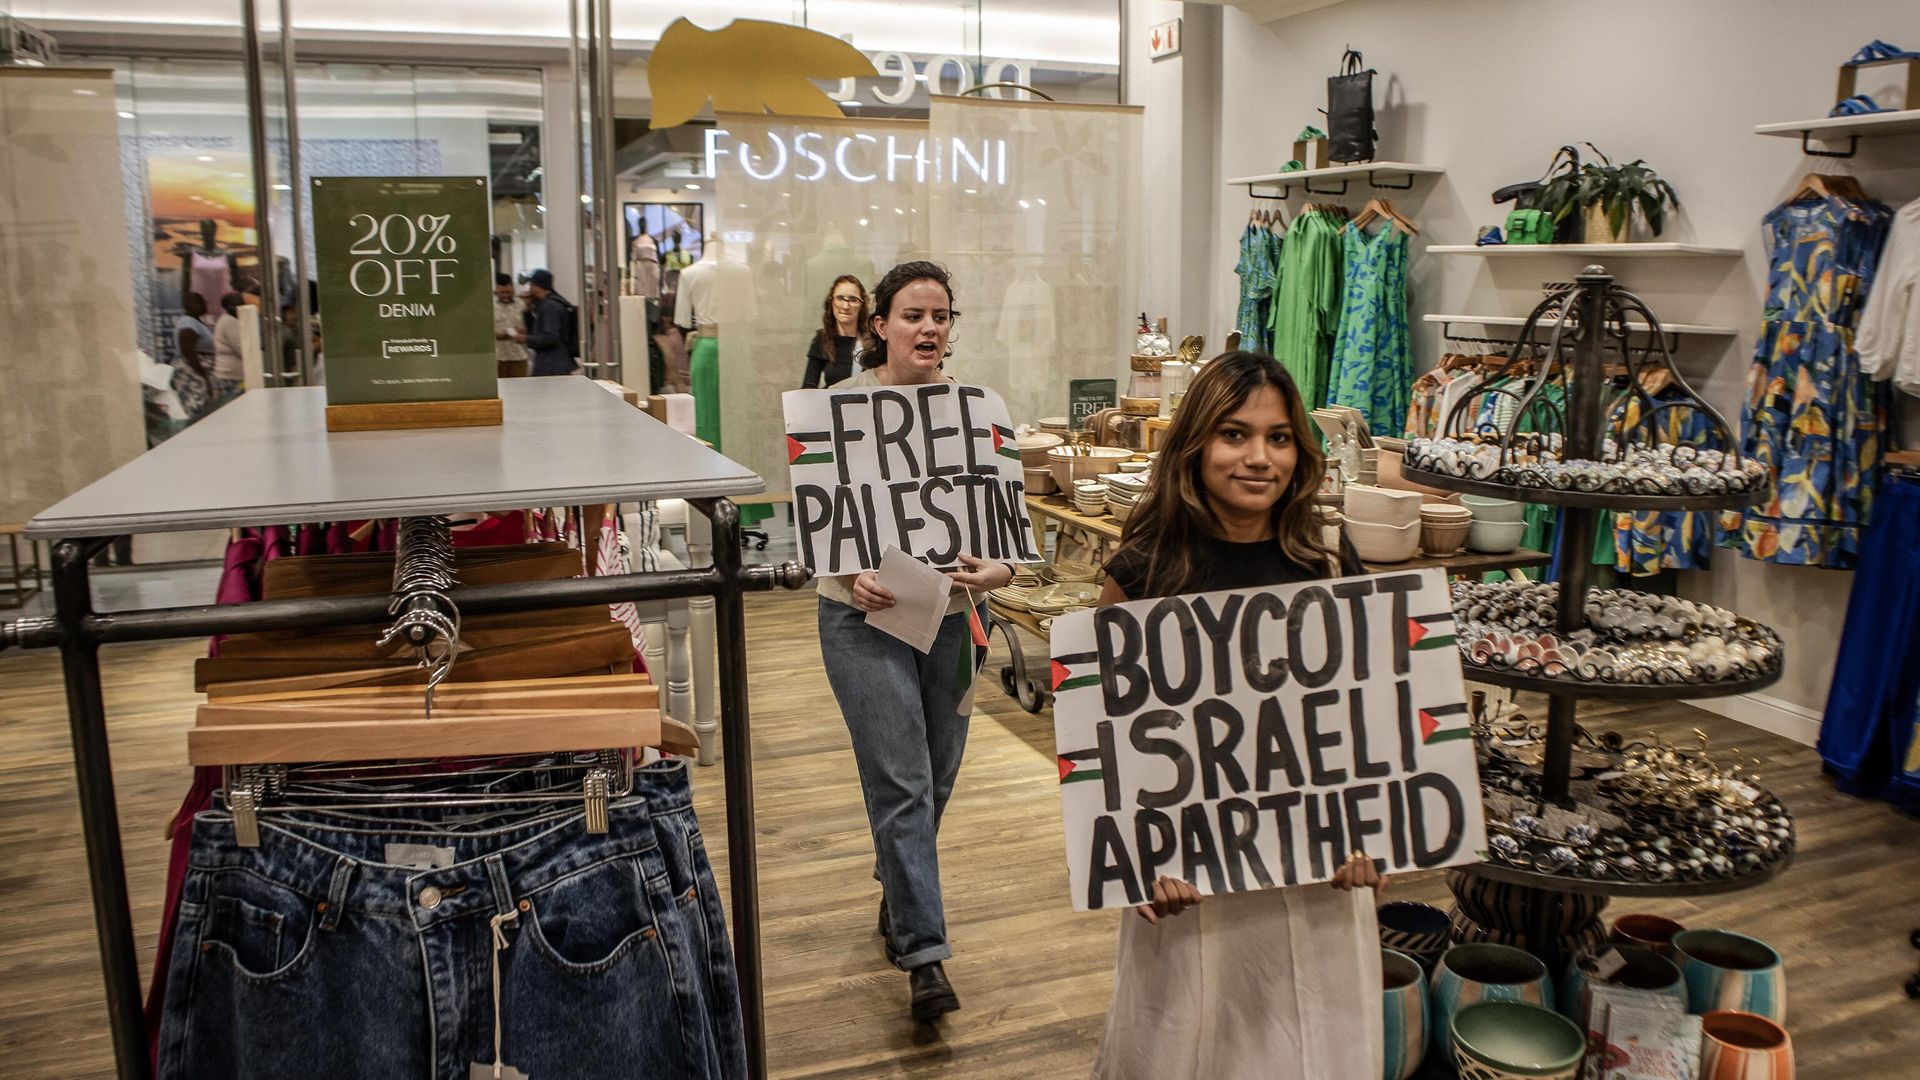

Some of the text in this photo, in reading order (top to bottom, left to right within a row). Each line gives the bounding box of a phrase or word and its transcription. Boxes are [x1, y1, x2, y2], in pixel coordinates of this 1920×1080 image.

[704, 129, 1006, 184] FOSCHINI
[349, 213, 457, 255] 20%
[350, 259, 459, 297] OFF
[379, 303, 436, 318] DENIM
[387, 345, 432, 353] REWARDS
[830, 385, 999, 485] FREE
[795, 475, 1042, 576] PALESTINE
[1094, 574, 1423, 717] BOYCOTT
[1097, 680, 1418, 811] ISRAELI
[1088, 772, 1465, 909] APARTHEID
